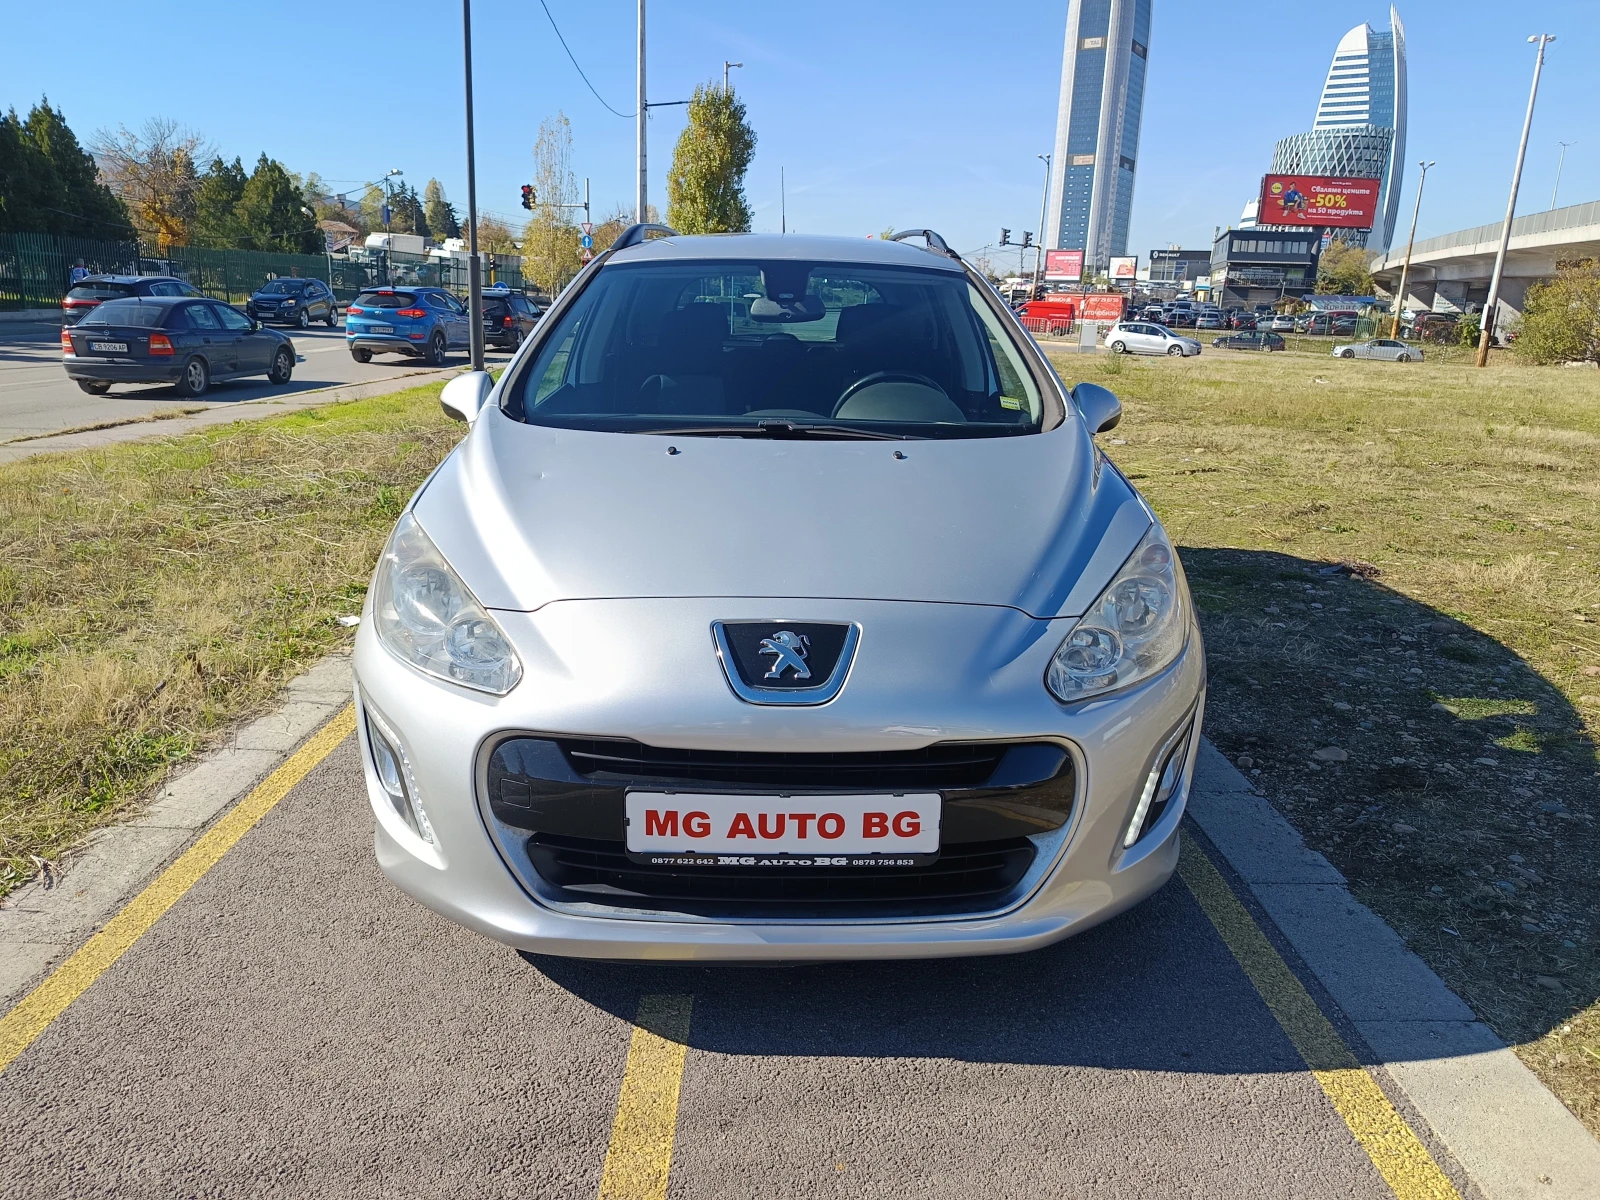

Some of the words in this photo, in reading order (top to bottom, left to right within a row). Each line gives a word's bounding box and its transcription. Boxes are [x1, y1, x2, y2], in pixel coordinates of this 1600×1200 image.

[1311, 185, 1342, 193] Сваляме
[1310, 194, 1347, 208] -50%
[1327, 208, 1363, 216] продукта
[103, 343, 117, 351] 9206
[645, 809, 711, 838] MG
[725, 812, 846, 839] AUTO
[862, 810, 922, 838] BG
[651, 857, 675, 865] 0877
[676, 857, 695, 865] 622
[696, 857, 714, 865] 642
[717, 856, 757, 866] MG
[813, 857, 849, 866] BG
[852, 858, 876, 866] 0878
[877, 858, 896, 866] 756
[896, 858, 915, 866] 853
